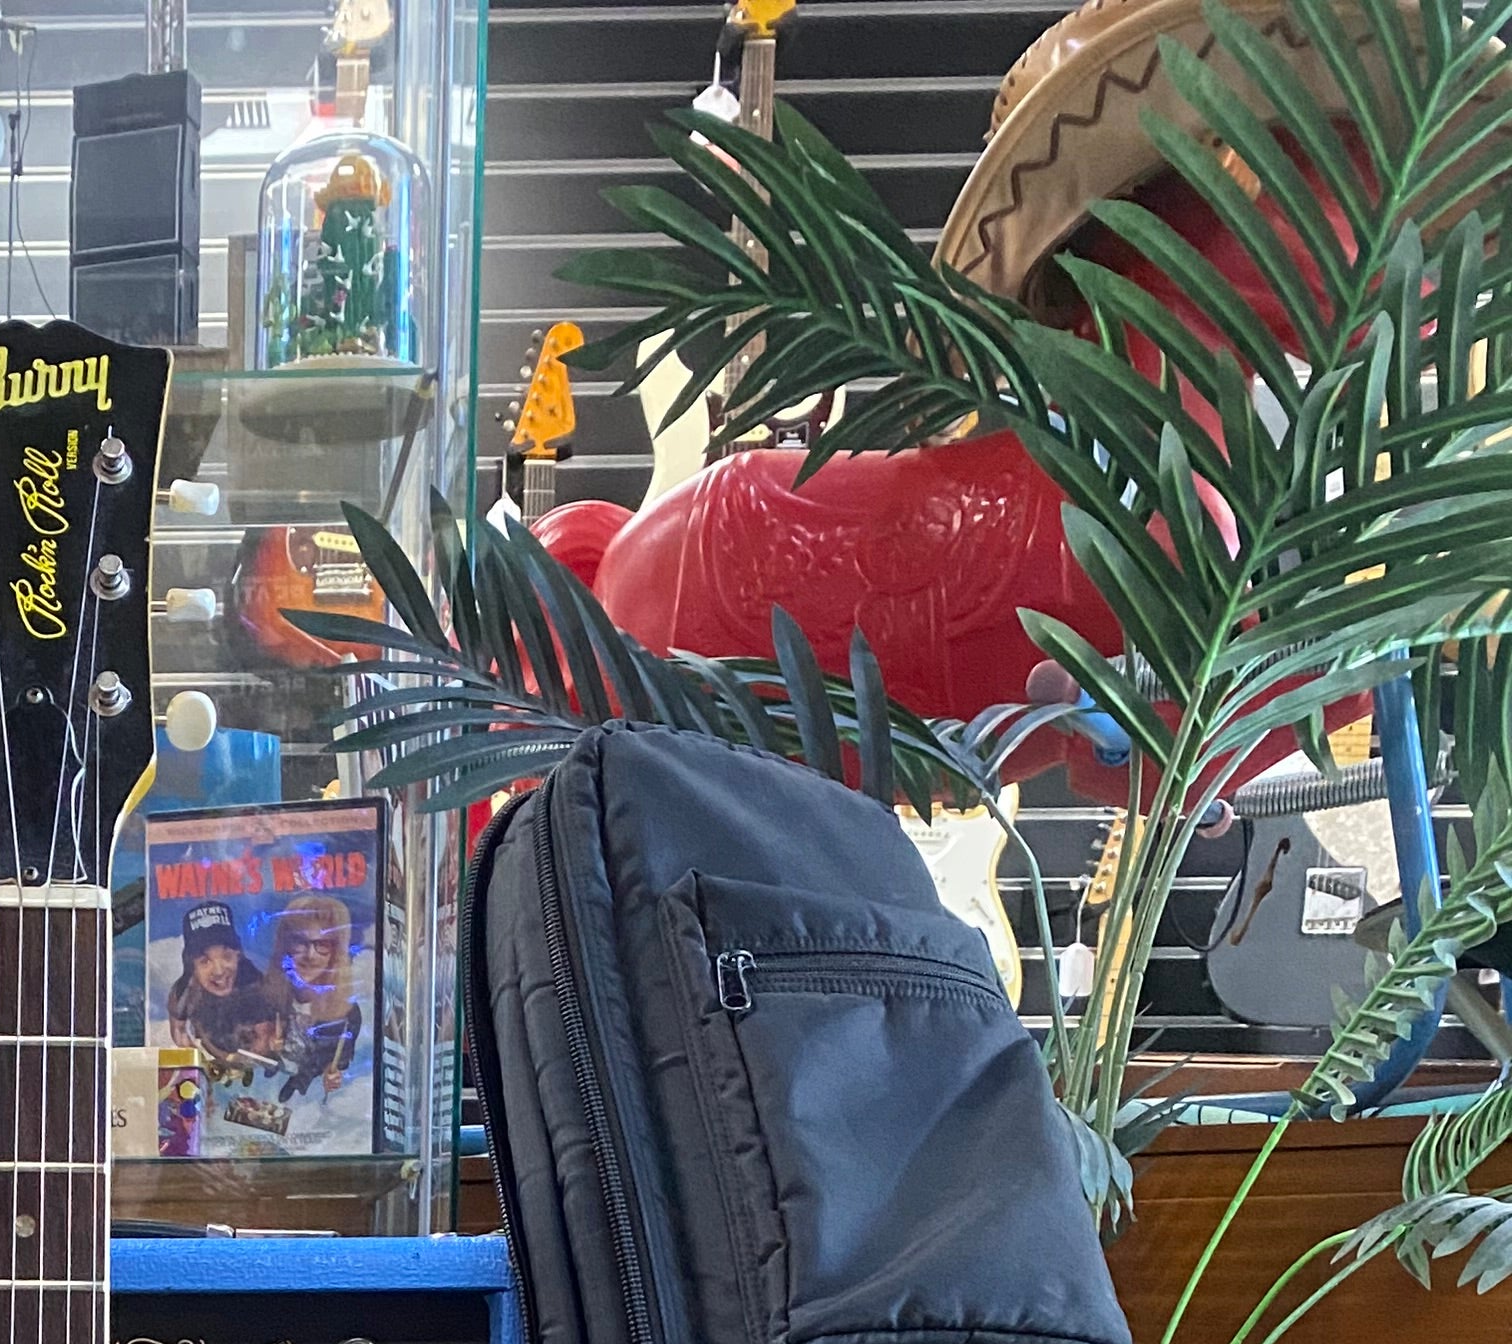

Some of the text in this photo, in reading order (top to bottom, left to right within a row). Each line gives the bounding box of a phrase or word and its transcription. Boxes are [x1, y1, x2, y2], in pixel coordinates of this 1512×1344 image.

[66, 429, 79, 470] VERSION
[13, 446, 70, 535] Roll
[155, 847, 264, 899] WAYNE'S
